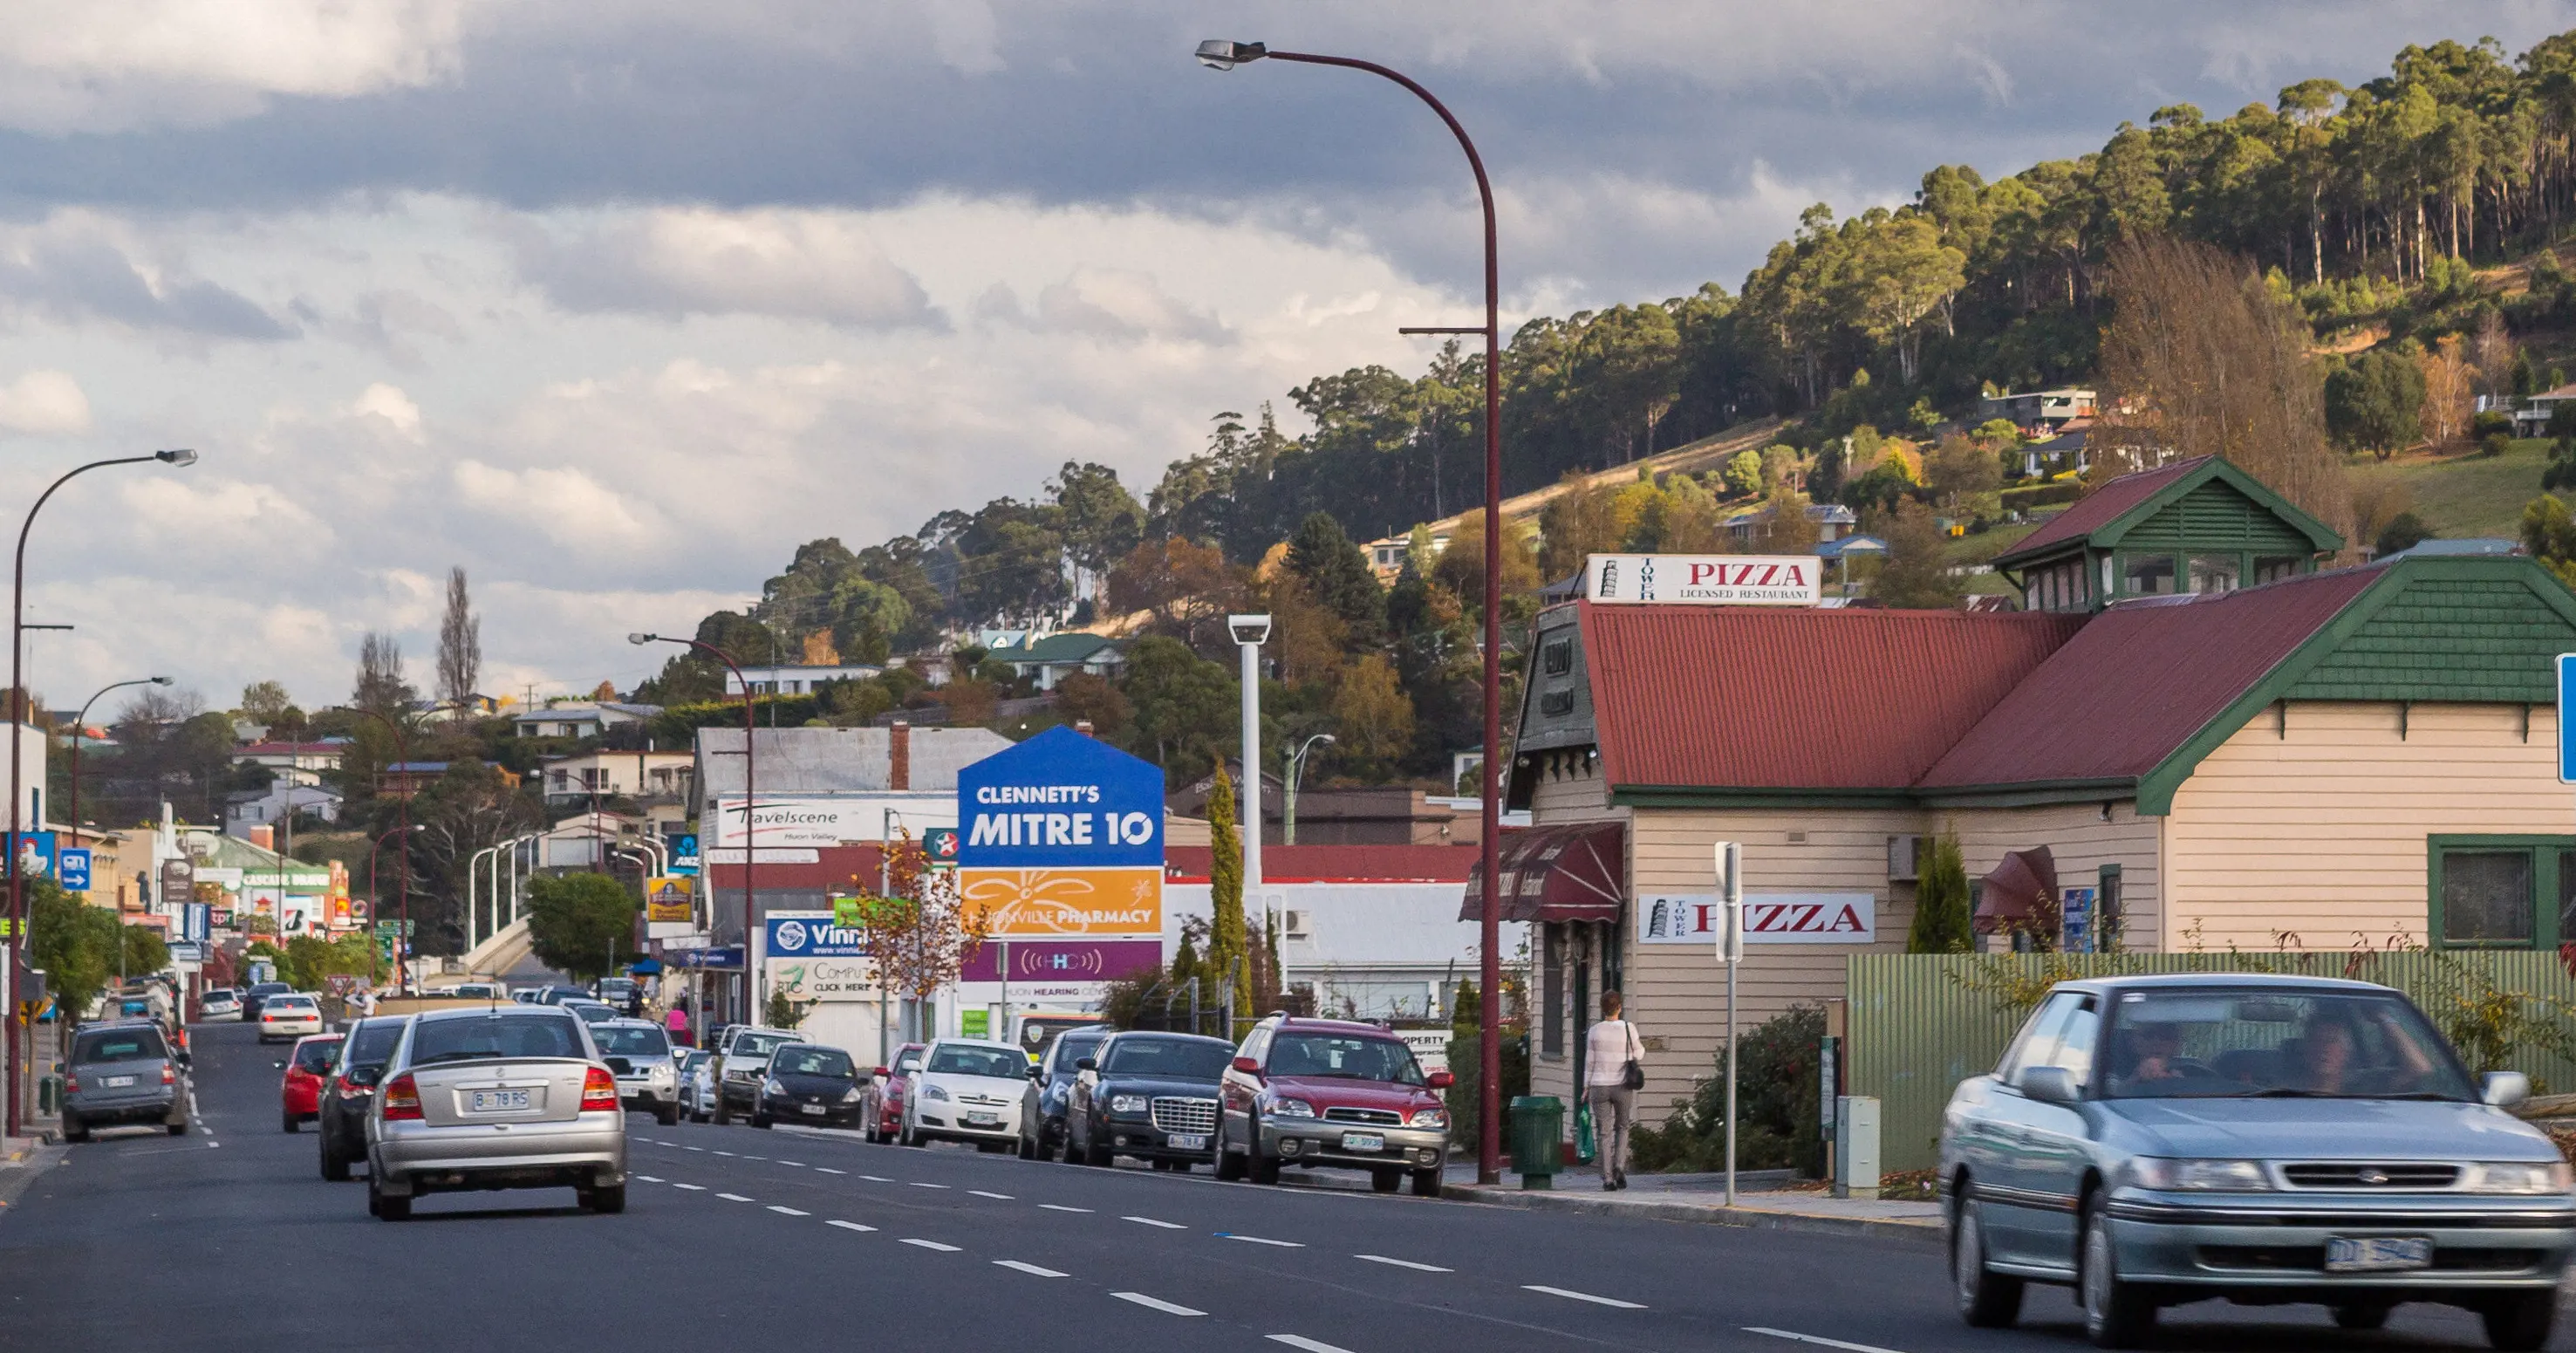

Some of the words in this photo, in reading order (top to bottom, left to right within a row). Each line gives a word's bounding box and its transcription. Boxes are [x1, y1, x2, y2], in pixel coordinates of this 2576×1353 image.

[1640, 557, 1655, 601] TOWER
[1687, 563, 1808, 587] PIZZA
[1679, 589, 1733, 598] LICENSED
[1739, 590, 1809, 599] RESTAURANT
[976, 786, 1100, 804] CLENNETT'S
[741, 807, 838, 823] Tavelscene
[967, 812, 1093, 846] MITRE
[1105, 811, 1154, 846] 10
[811, 833, 838, 842] Valley
[674, 856, 699, 866] ANZ
[1057, 909, 1152, 925] PHARMACY
[1674, 900, 1686, 937] TOWER
[814, 961, 870, 981] COMPUT
[814, 983, 841, 992] CLICK
[1034, 987, 1079, 996] HEARING
[1402, 1035, 1445, 1045] OPERTY
[495, 1092, 509, 1105] 78
